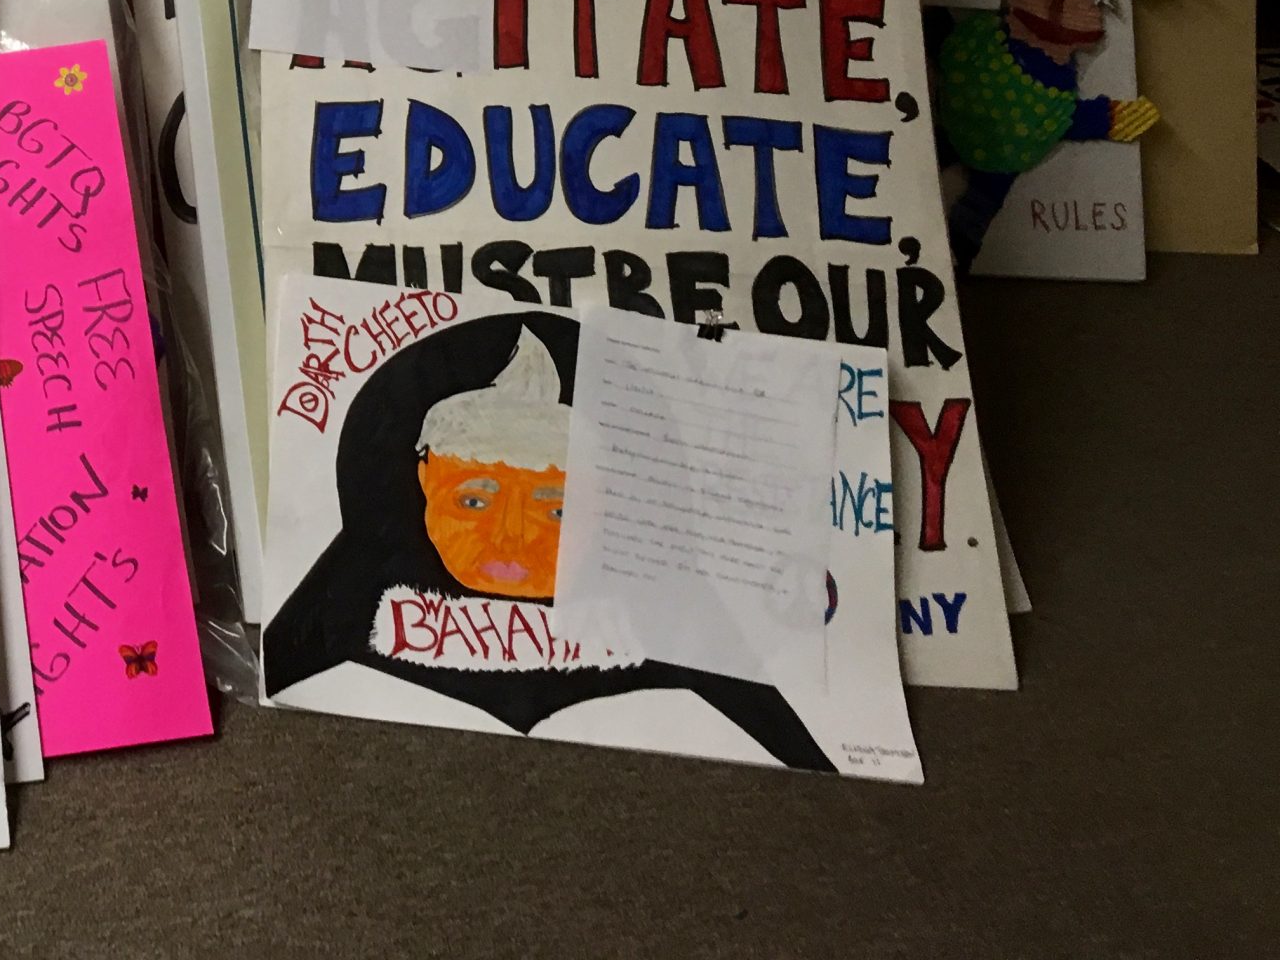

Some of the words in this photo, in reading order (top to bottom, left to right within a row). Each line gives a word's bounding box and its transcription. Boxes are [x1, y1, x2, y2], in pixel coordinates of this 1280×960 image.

[310, 97, 922, 266] EDUCATE,
[1029, 198, 1129, 233] RULES
[23, 283, 83, 433] SPEECH
[77, 268, 136, 391] FREE
[277, 296, 351, 435] DARTH
[342, 290, 461, 376] CHEETO
